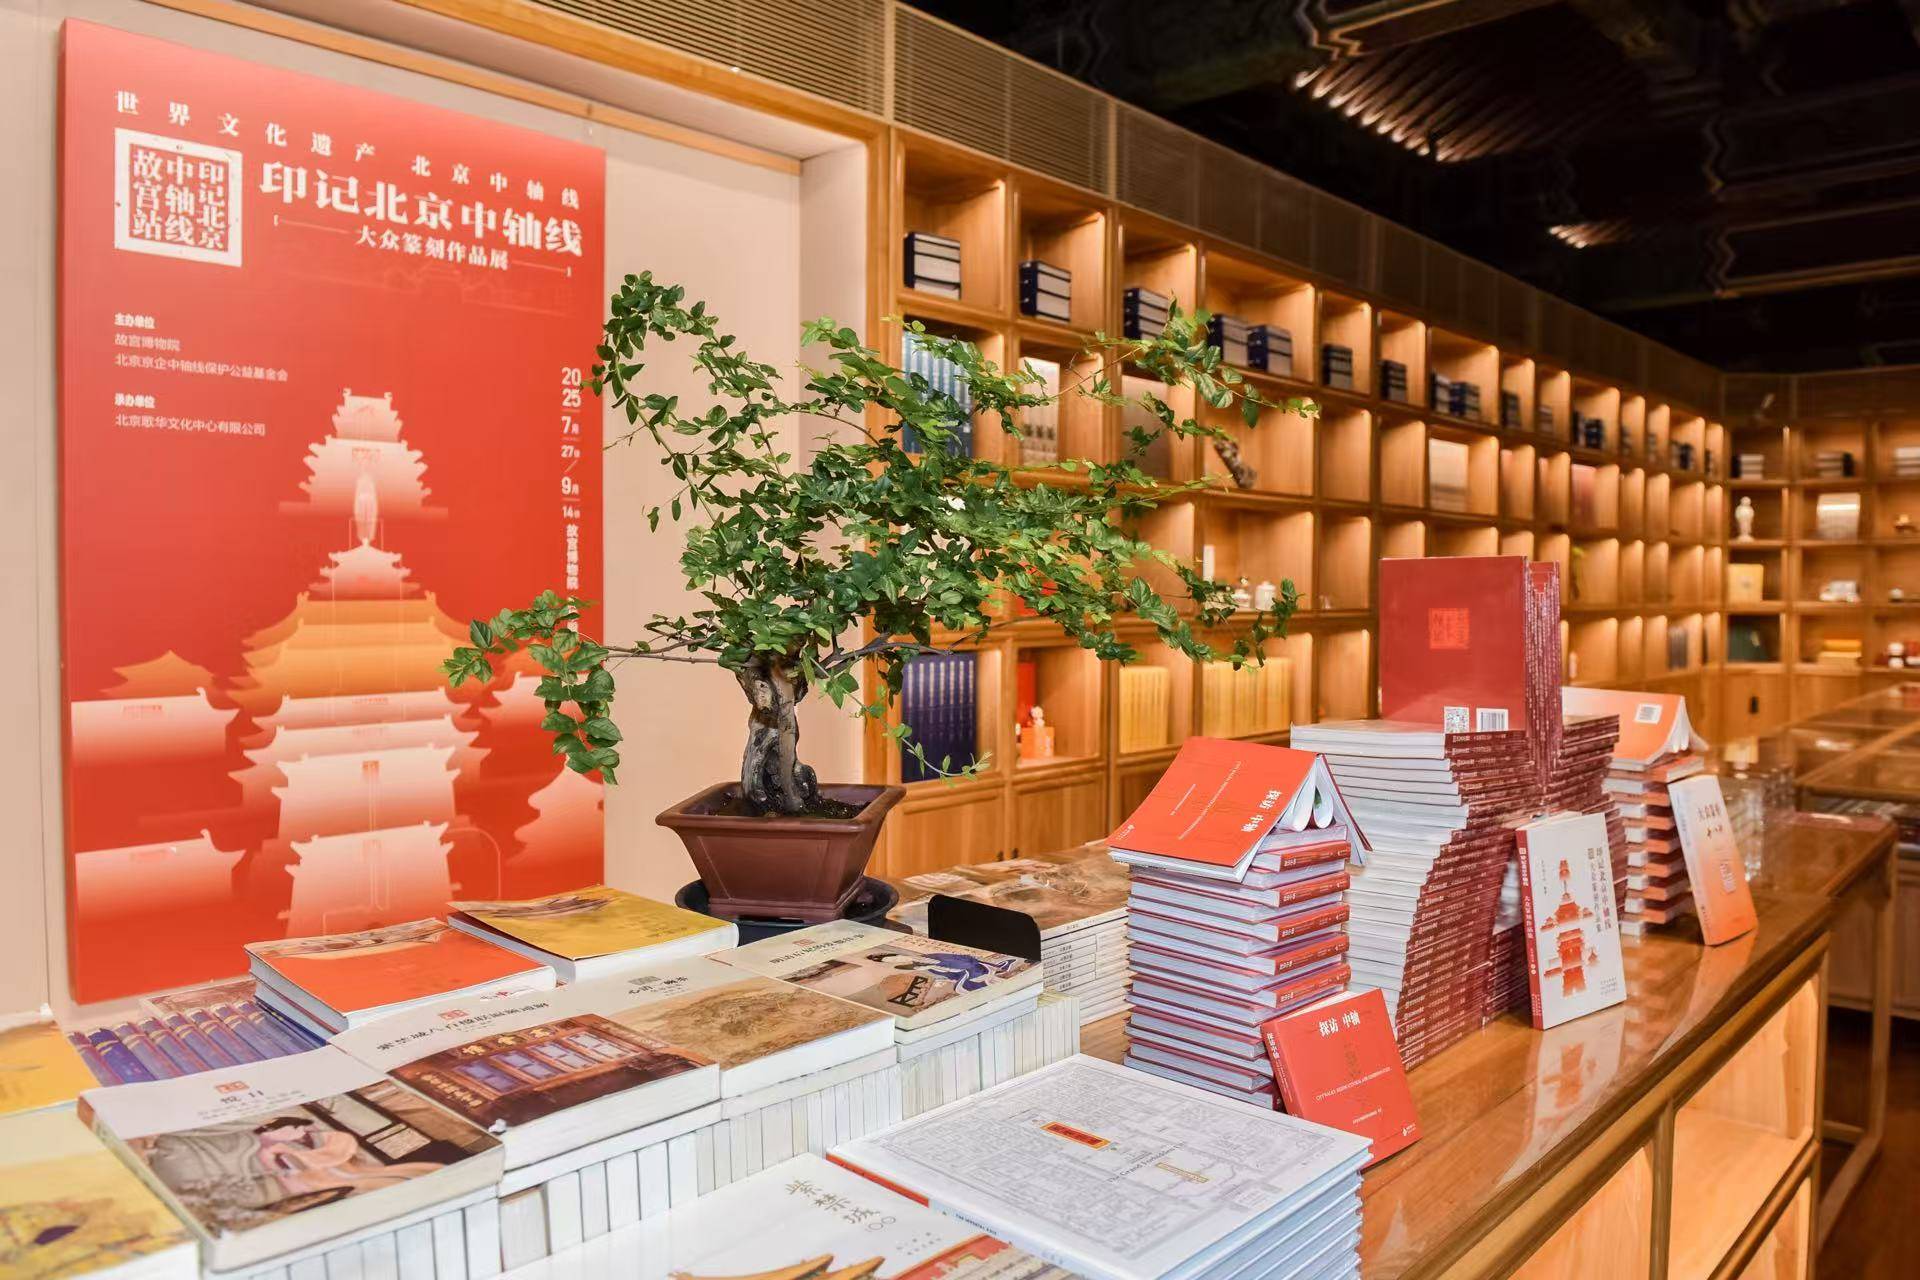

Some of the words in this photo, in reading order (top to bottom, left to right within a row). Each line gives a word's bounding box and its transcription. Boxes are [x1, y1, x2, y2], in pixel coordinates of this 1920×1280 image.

[114, 90, 375, 162] 世界文化遗产
[411, 155, 580, 210] 北京中轴线
[259, 161, 583, 257] 印记北京中轴线
[356, 225, 510, 271] 大众篆刻作品展
[114, 333, 181, 352] 故宫博物院
[561, 367, 582, 386] 20
[562, 388, 582, 408] 25
